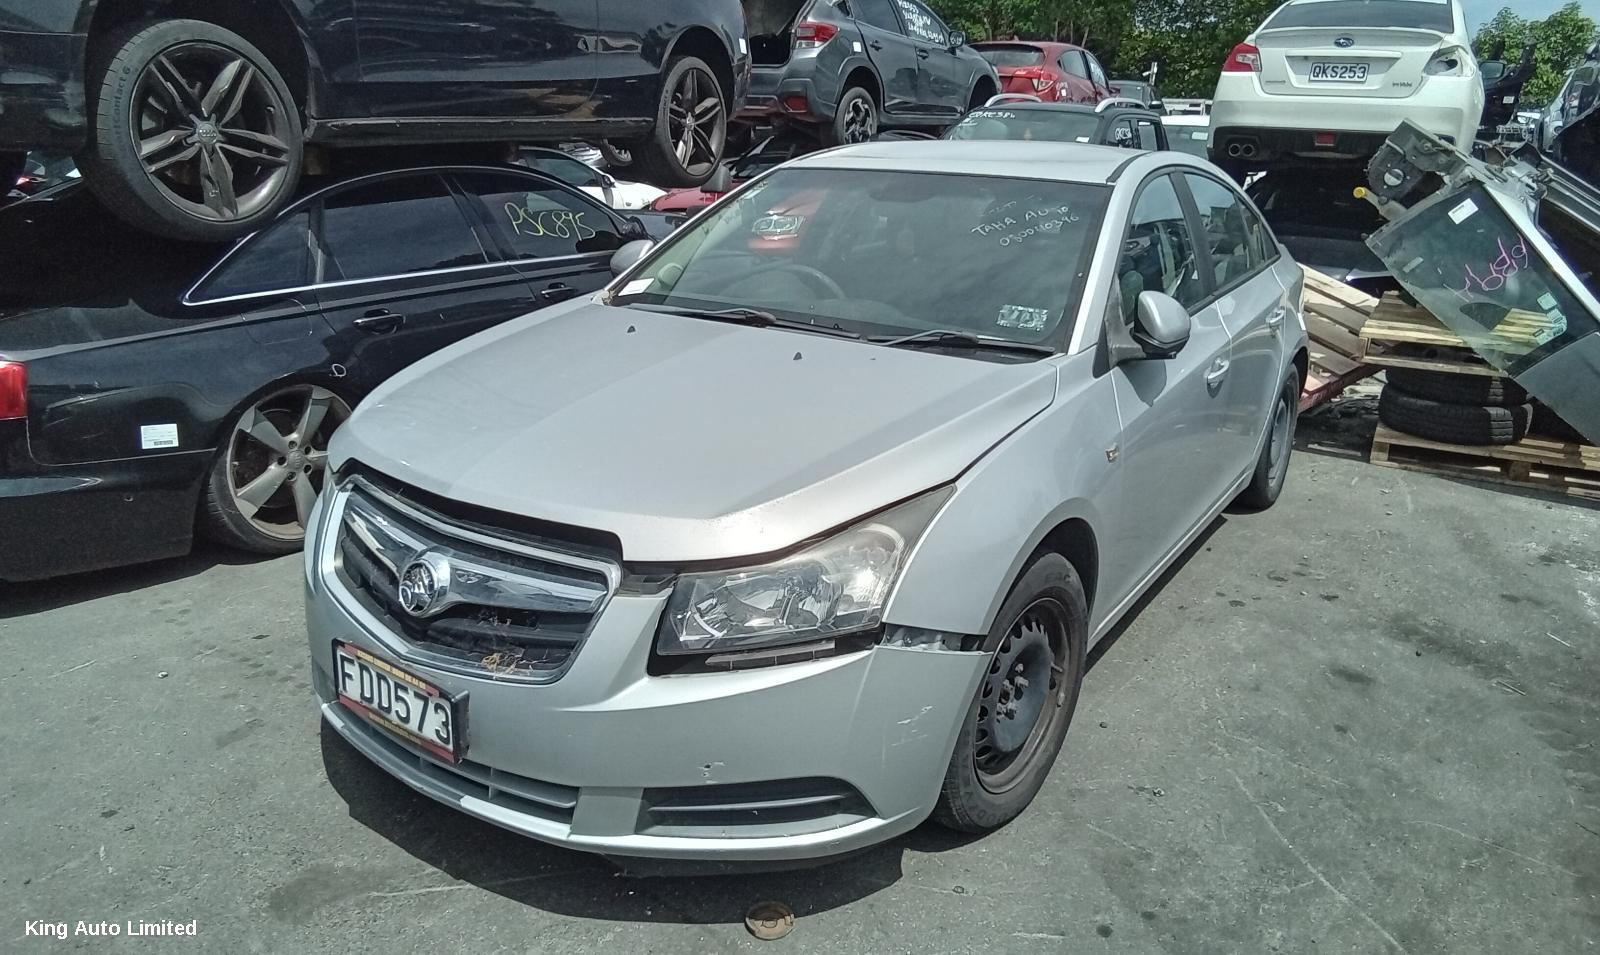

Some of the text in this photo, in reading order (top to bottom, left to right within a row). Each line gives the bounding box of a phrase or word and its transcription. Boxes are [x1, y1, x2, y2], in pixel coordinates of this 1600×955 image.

[1312, 65, 1367, 79] QKS253
[504, 202, 596, 241] PSC895
[971, 217, 1017, 235] TAHA
[339, 654, 452, 746] FDD573
